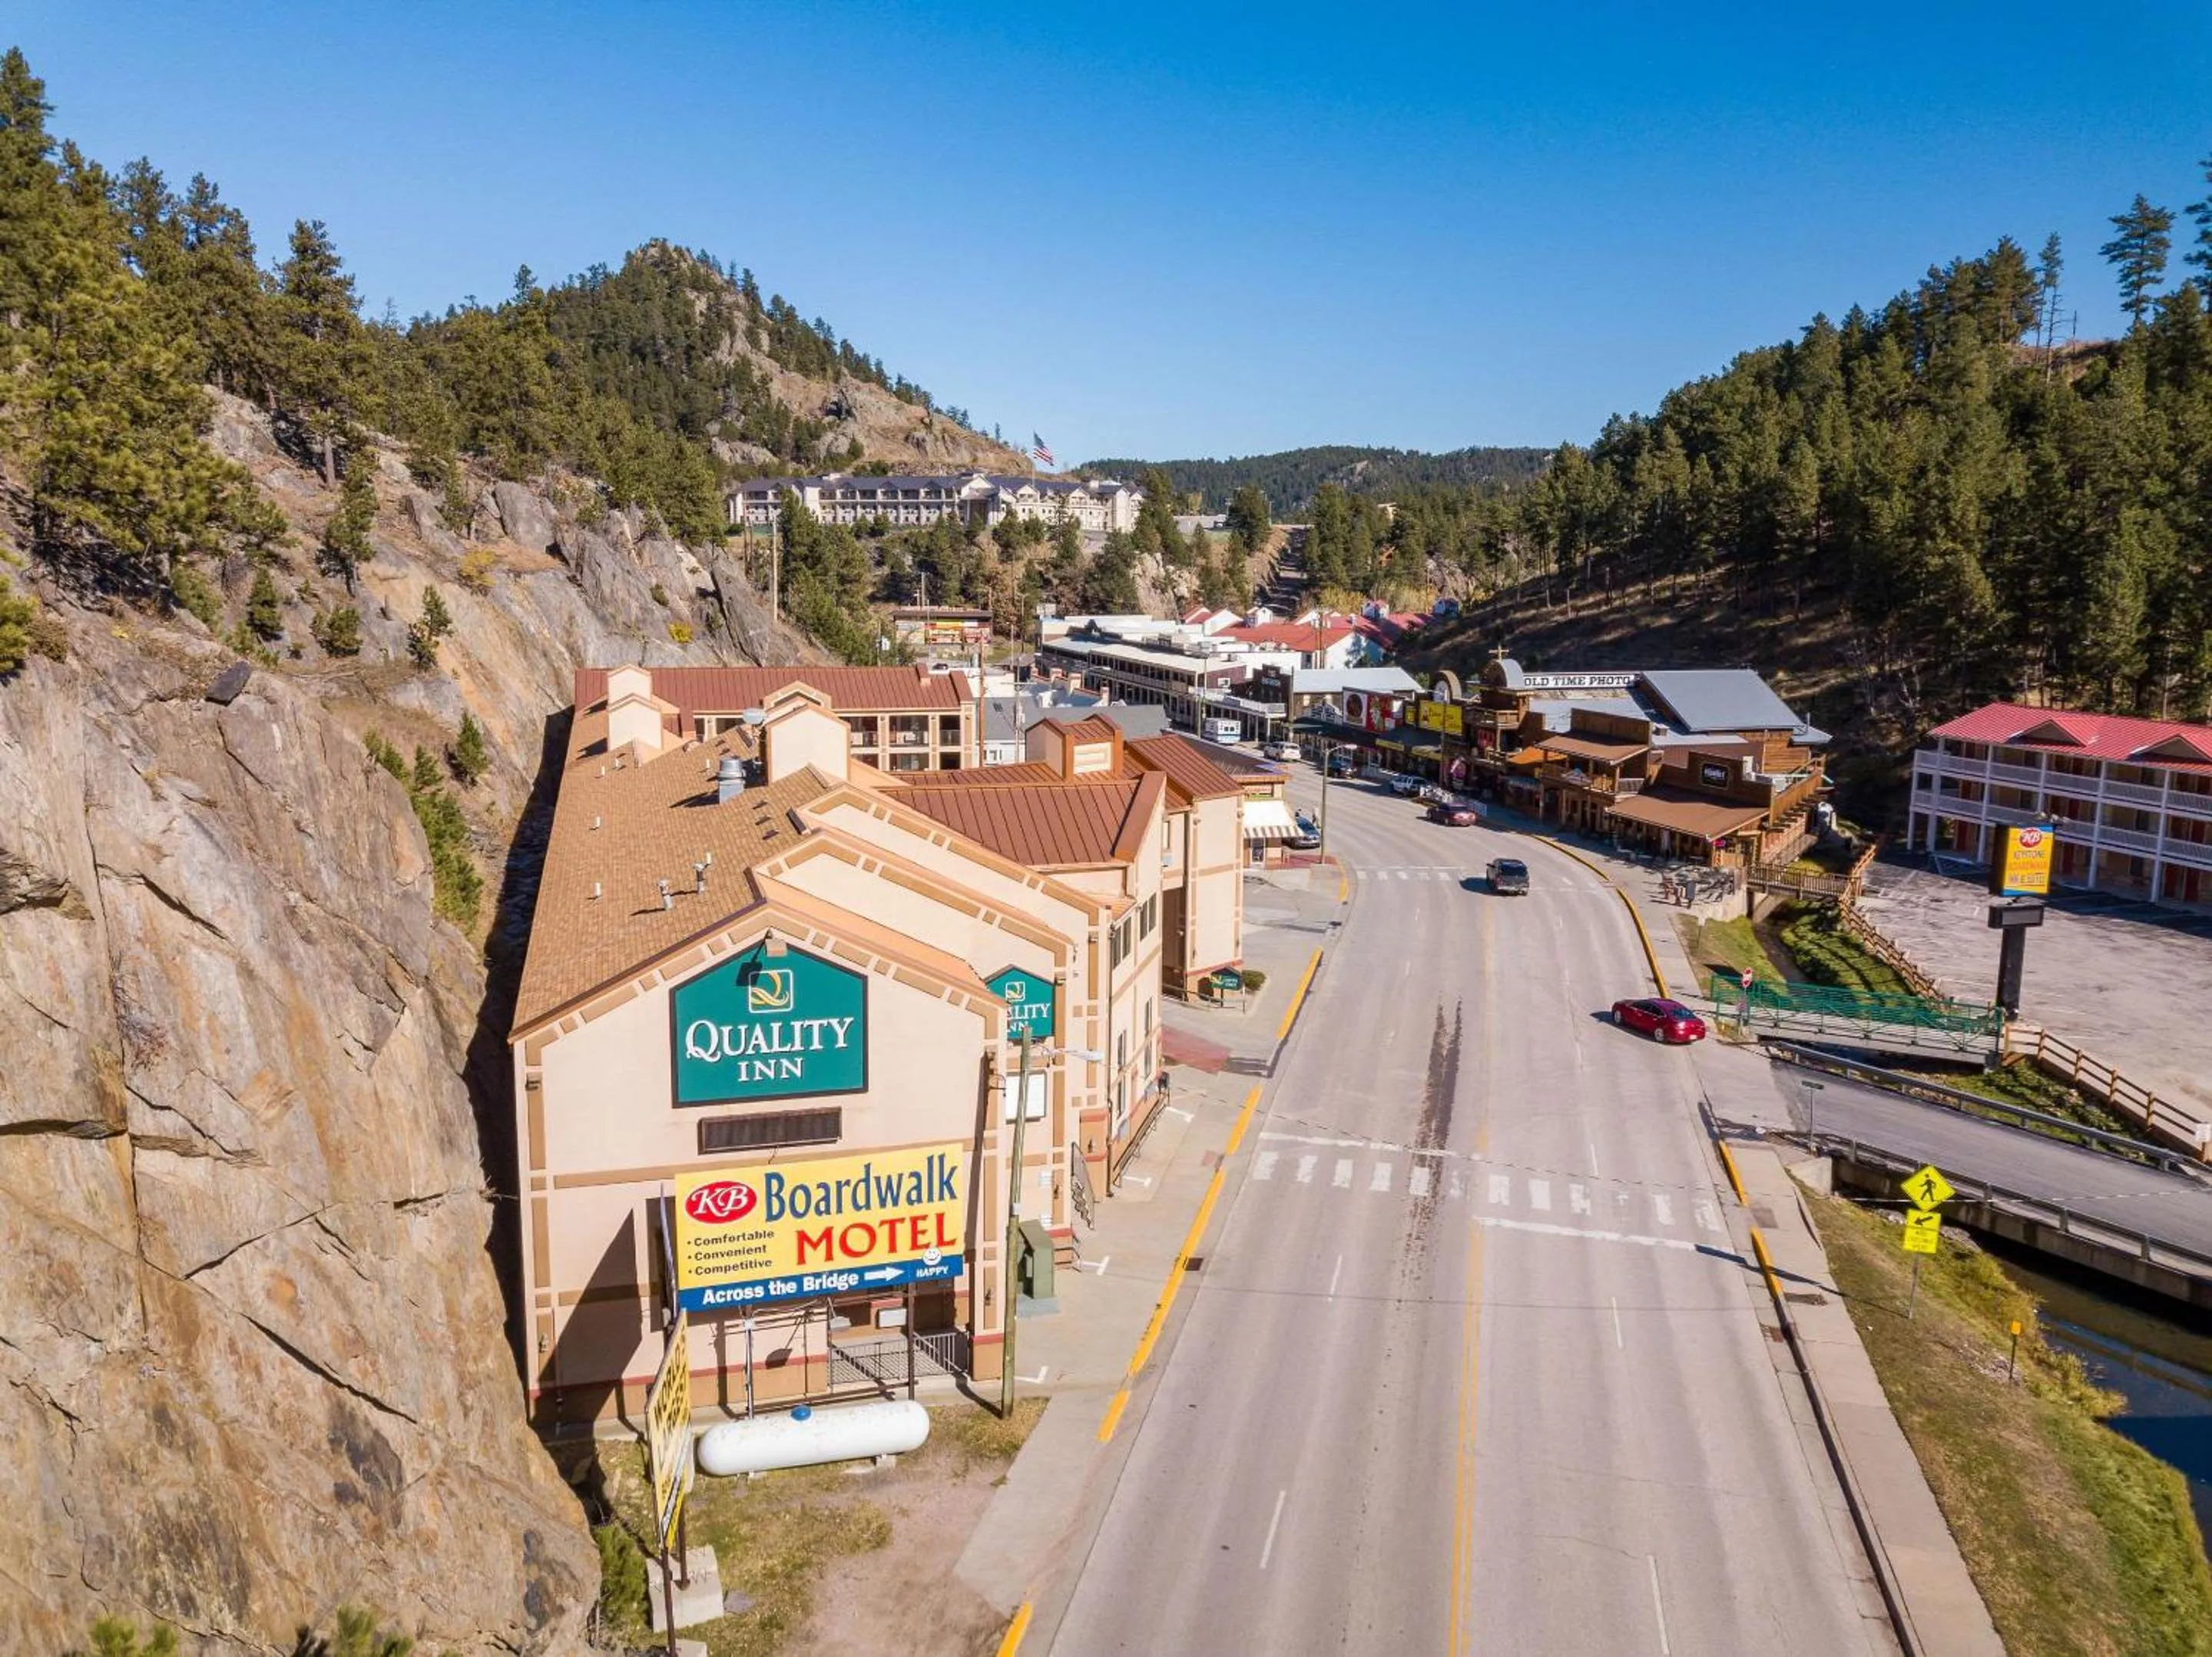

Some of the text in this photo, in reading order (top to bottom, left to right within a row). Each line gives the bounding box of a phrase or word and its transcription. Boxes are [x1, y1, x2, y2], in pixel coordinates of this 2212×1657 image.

[1524, 676, 1631, 686] OLD TIME PHOTO
[1007, 1002, 1051, 1020] ALITY
[685, 1017, 854, 1063] QUALITY
[737, 1057, 806, 1082] INN
[691, 1153, 959, 1223] KB Boardwalk
[694, 1229, 775, 1247] Comfortable
[796, 1212, 957, 1265] MOTEL
[694, 1245, 767, 1262] Convenient
[695, 1259, 773, 1276] Competitive
[916, 1265, 949, 1278] HAPPY
[702, 1272, 859, 1305] Across the Bridge
